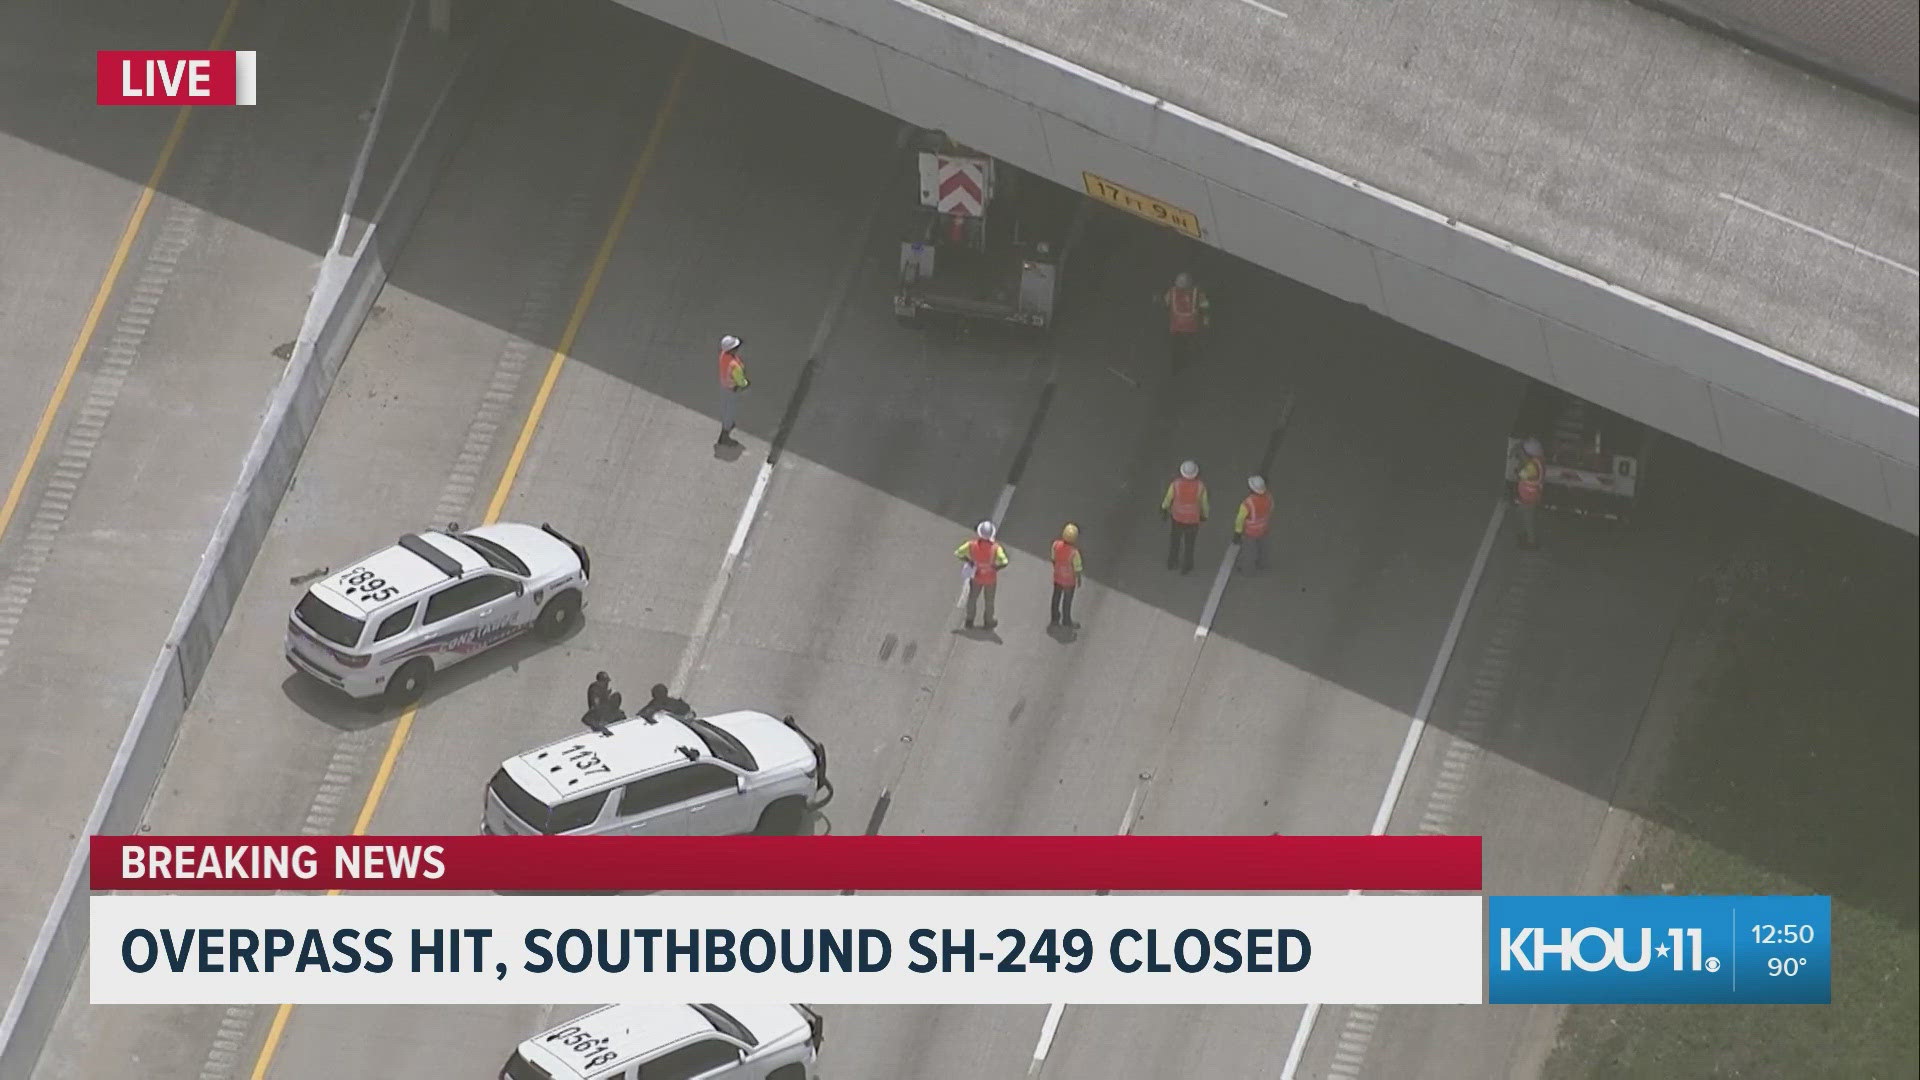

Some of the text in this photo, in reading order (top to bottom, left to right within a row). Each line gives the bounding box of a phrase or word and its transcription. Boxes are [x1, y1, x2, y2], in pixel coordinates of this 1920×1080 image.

[1098, 181, 1119, 201] 17
[1125, 196, 1142, 212] FT
[1152, 203, 1168, 220] 9
[561, 744, 612, 776] 1137
